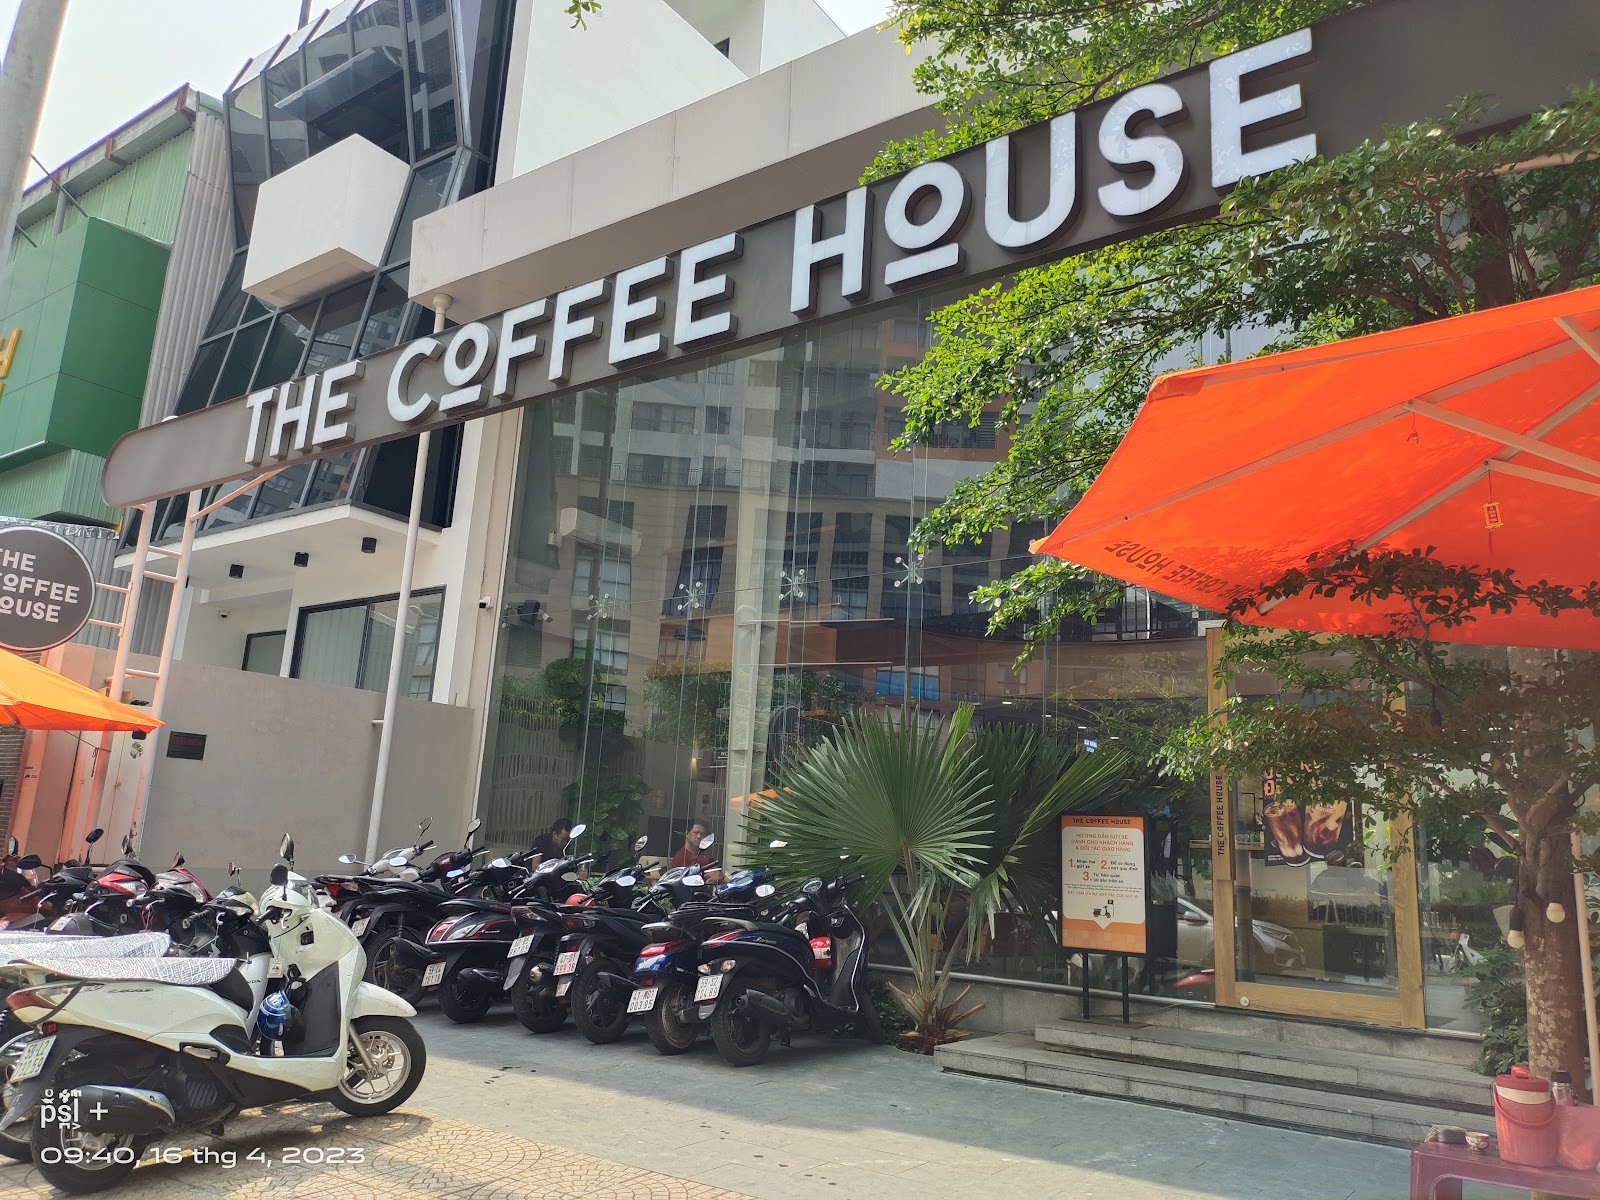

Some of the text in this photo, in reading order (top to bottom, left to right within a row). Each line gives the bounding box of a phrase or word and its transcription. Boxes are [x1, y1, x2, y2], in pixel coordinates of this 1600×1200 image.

[244, 27, 1317, 465] THE COFFEE HOUSE
[0, 572, 80, 604] OFFEE
[1215, 775, 1225, 856] THE COFFEE HOUSE
[1082, 871, 1092, 881] 3.
[1100, 859, 1110, 870] 2.
